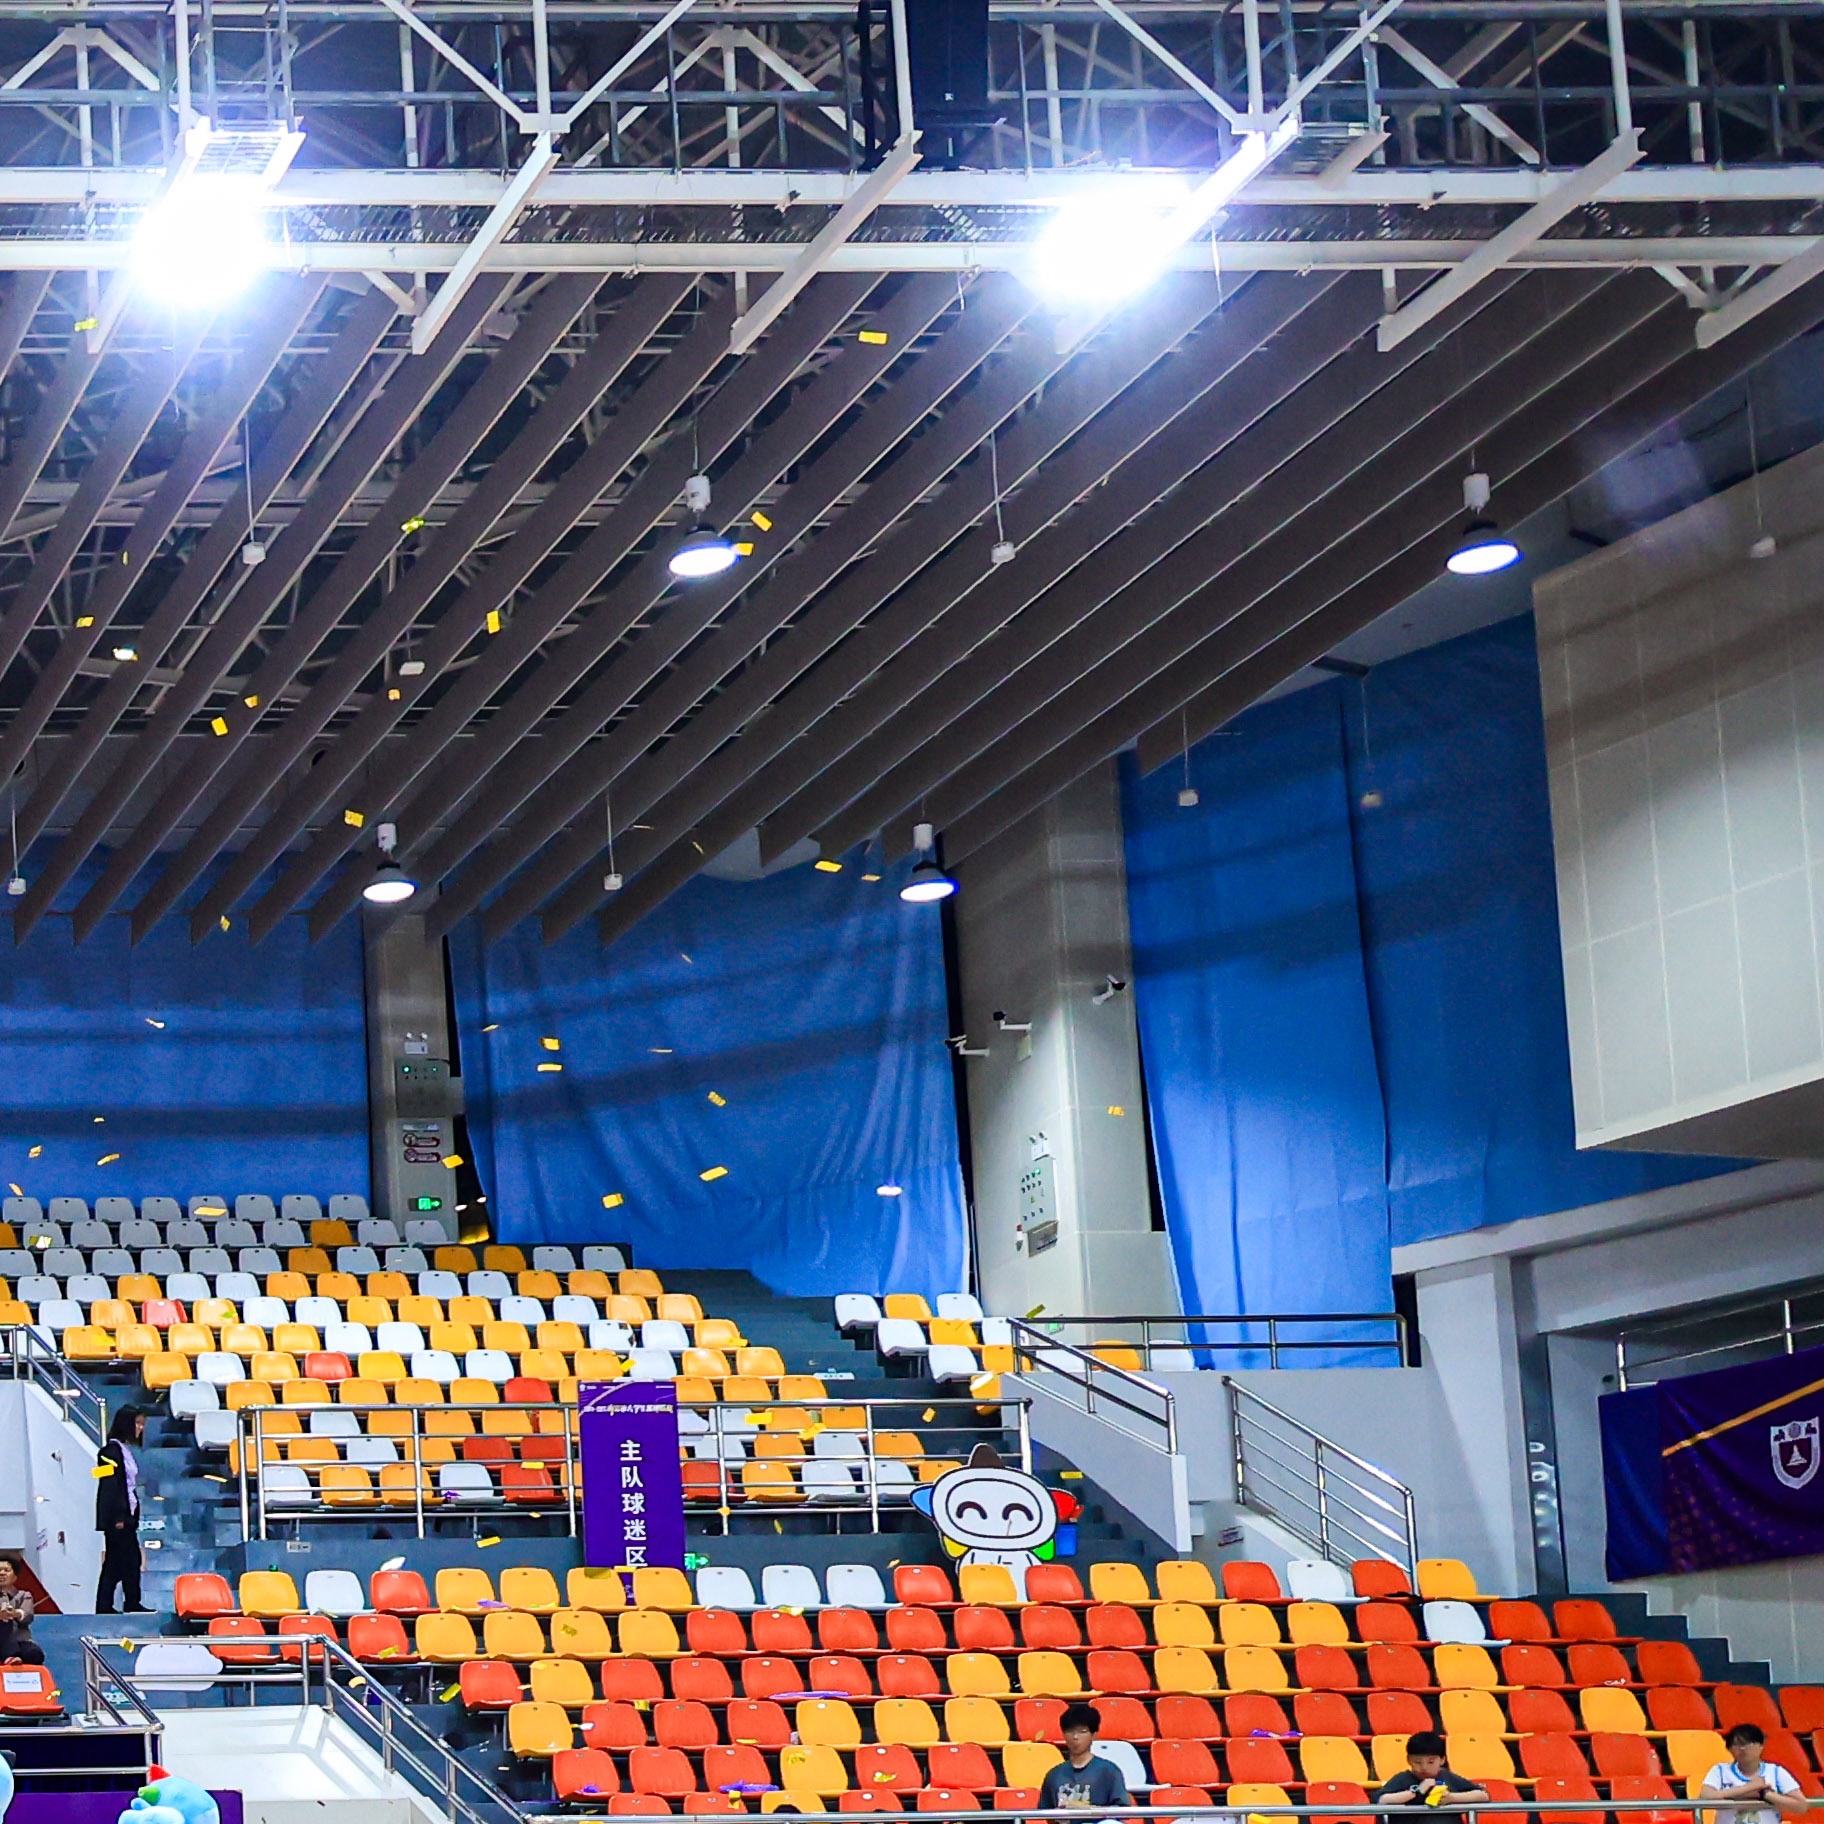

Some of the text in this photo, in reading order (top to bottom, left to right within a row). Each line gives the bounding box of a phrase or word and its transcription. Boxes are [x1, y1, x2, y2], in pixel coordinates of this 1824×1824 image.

[619, 1439, 648, 1567] 主队球迷区
